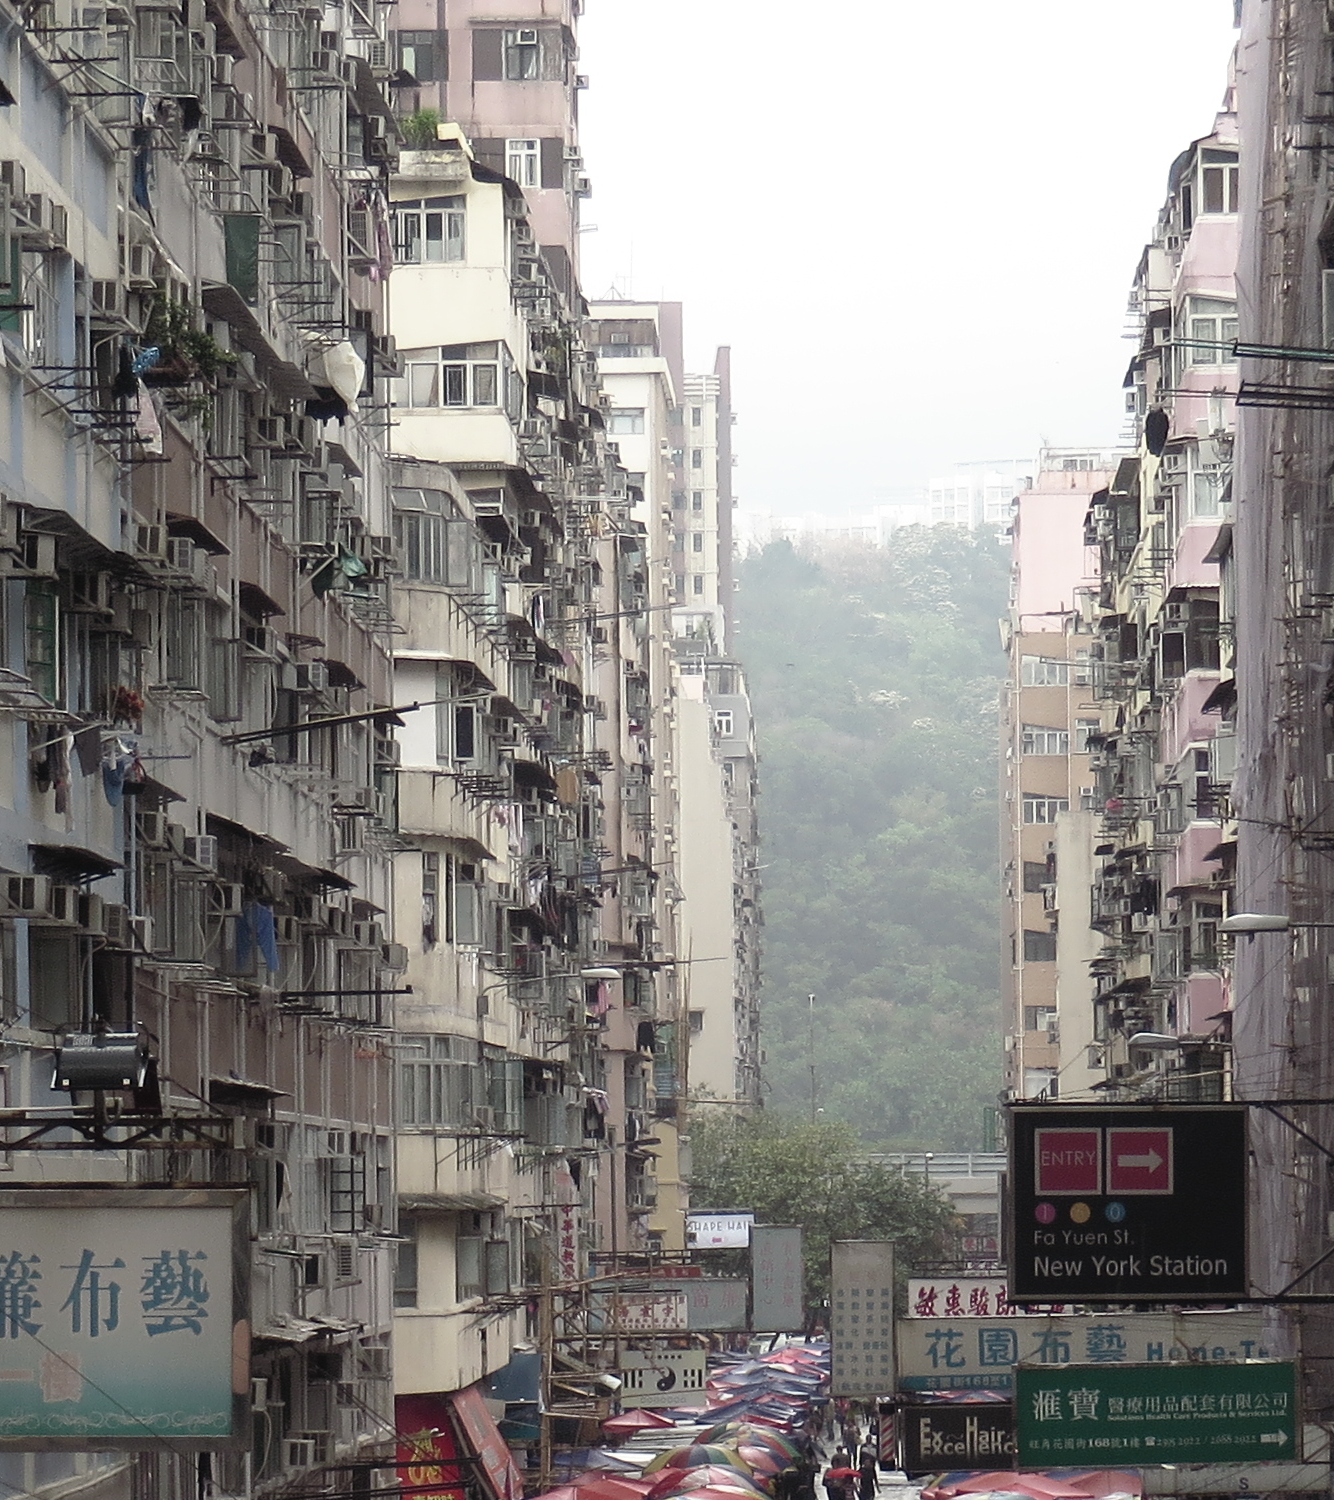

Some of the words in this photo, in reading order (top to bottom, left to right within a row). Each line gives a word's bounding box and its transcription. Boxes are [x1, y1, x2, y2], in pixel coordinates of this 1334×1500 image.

[1041, 1150, 1097, 1166] ENTRY
[1034, 1230, 1055, 1245] Fa
[1062, 1230, 1108, 1245] Yuen
[1113, 1229, 1135, 1245] St.
[1034, 1256, 1082, 1276] New
[1091, 1255, 1142, 1276] York
[1149, 1254, 1228, 1276] Station
[925, 1324, 1127, 1369] 花園布藝
